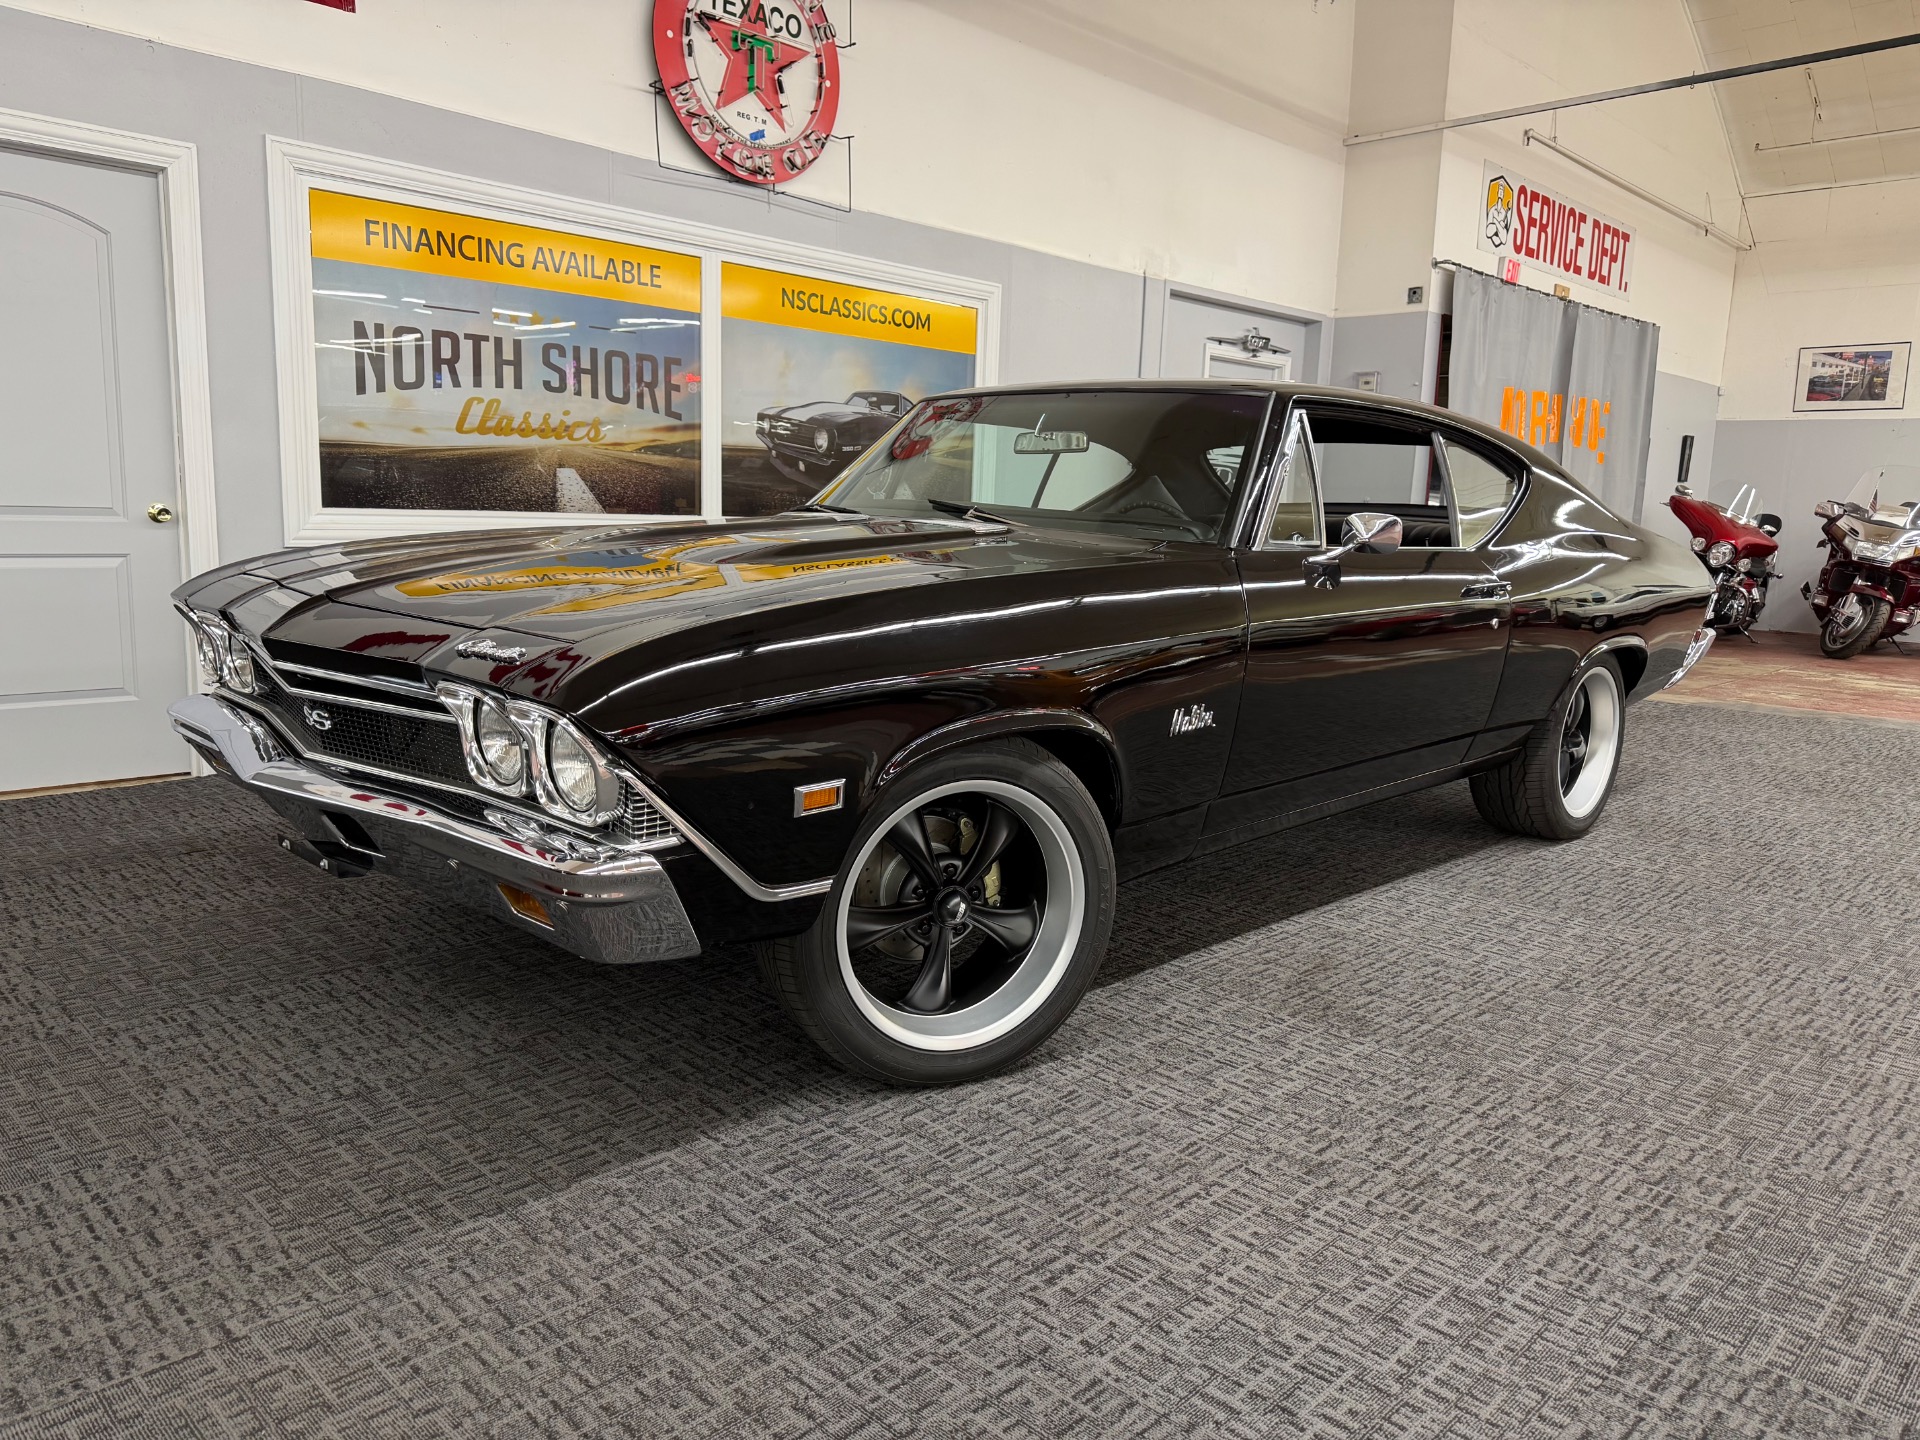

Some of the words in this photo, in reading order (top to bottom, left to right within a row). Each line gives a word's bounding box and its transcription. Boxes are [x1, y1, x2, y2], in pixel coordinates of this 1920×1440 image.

[669, 83, 775, 180] MOTOR
[364, 218, 525, 268] FINANCING
[531, 246, 662, 289] AVAILABLE
[1512, 184, 1588, 277] SERVICE
[1587, 217, 1631, 293] DEPT.
[781, 287, 931, 332] NSCLASSICS.COM
[353, 320, 523, 396] NORTH
[541, 342, 683, 422] SHORE
[455, 396, 607, 443] Classics
[303, 705, 331, 731] SS
